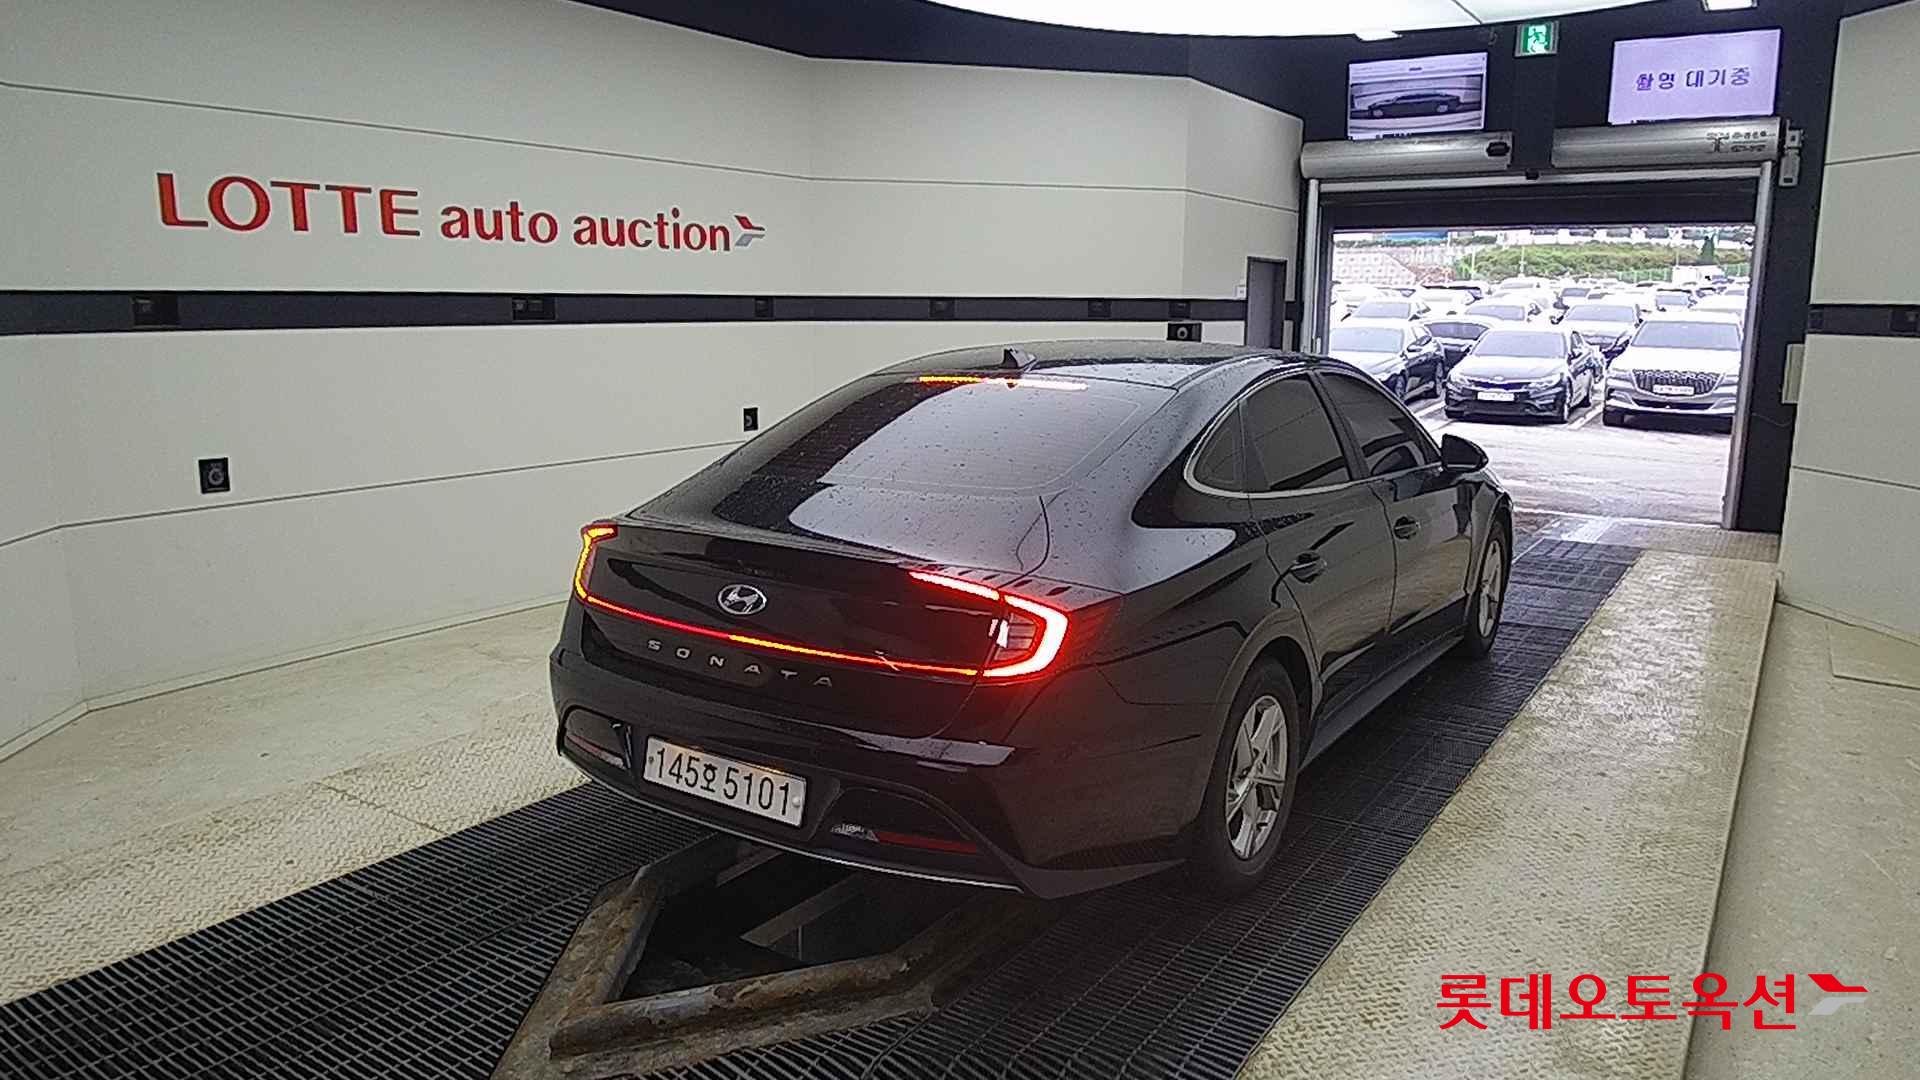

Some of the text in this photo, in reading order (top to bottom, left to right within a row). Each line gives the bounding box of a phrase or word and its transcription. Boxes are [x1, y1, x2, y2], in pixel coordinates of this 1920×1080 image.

[1686, 67, 1750, 88] 대기중
[156, 172, 731, 251] LOTTE auto auction
[648, 639, 833, 688] SONATA
